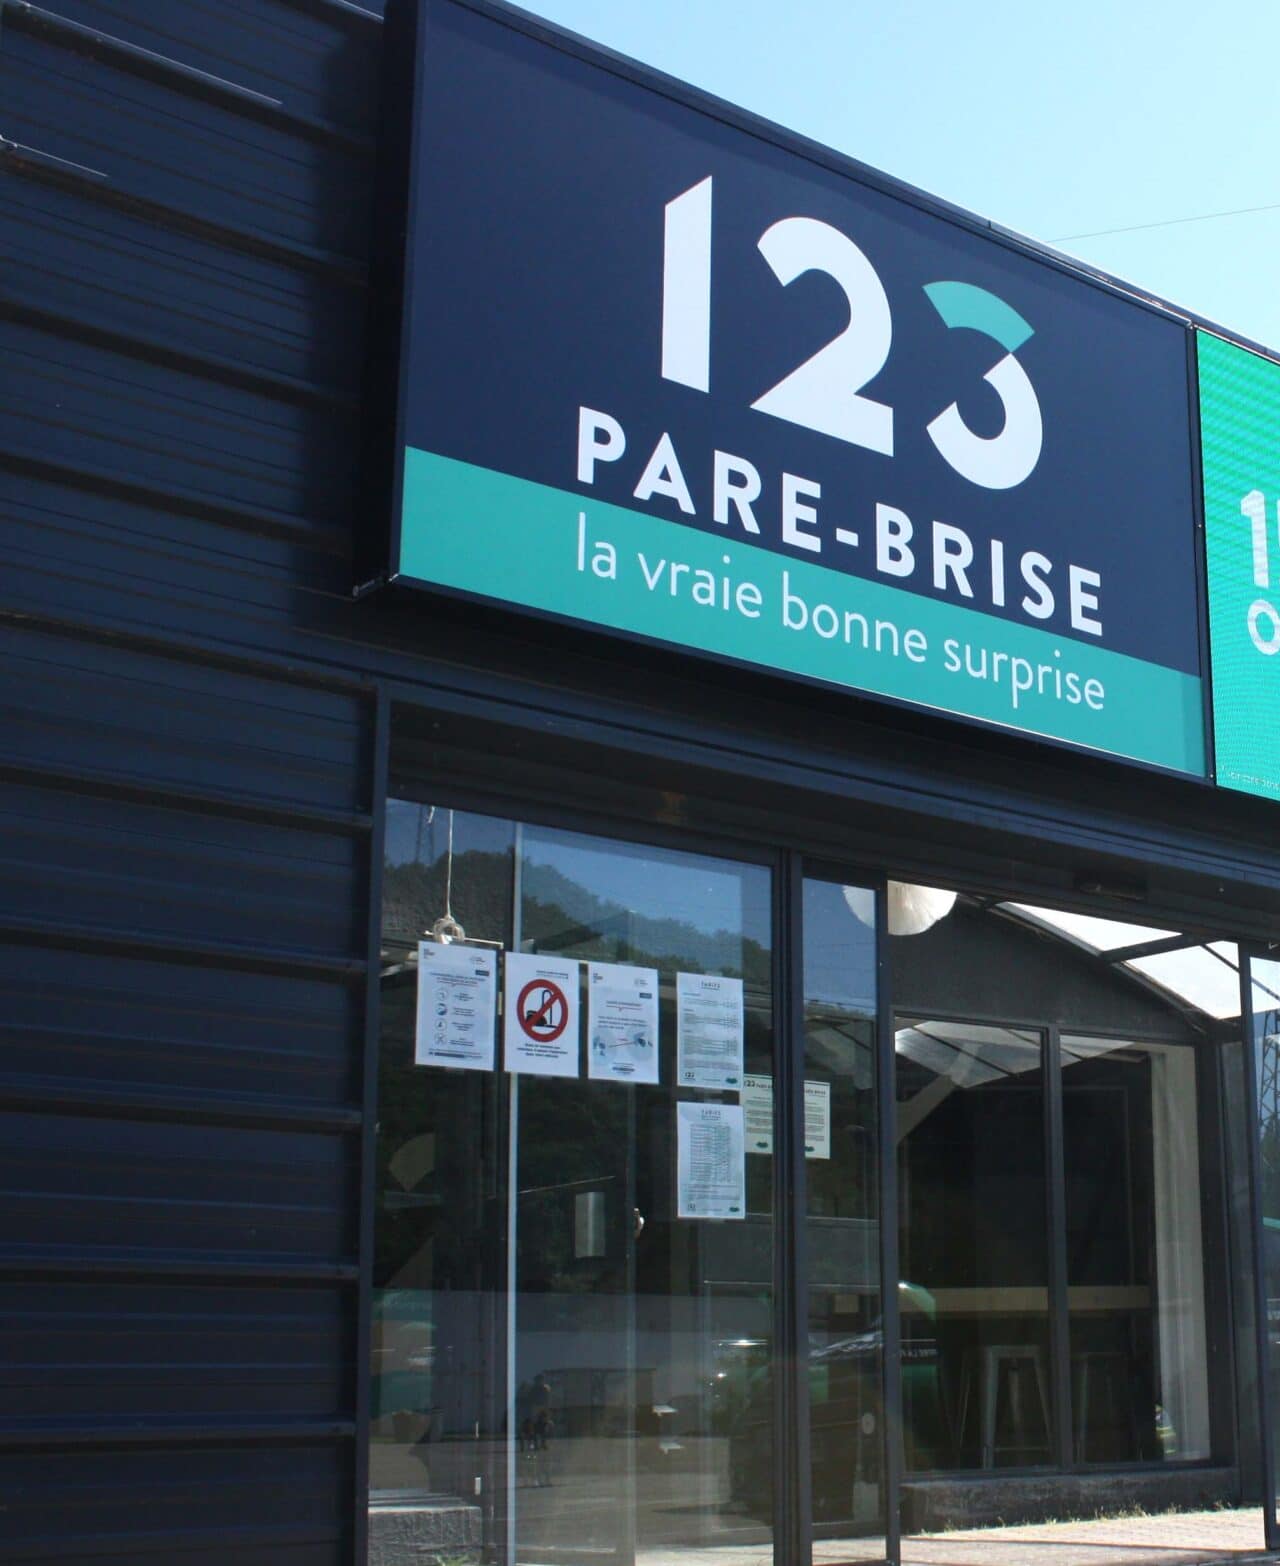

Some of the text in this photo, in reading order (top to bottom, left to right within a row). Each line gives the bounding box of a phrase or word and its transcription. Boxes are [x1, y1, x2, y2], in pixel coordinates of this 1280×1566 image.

[661, 175, 1043, 490] 123
[576, 405, 1103, 636] PARE-BRISE
[576, 512, 1105, 709] la vraie bonne surprise
